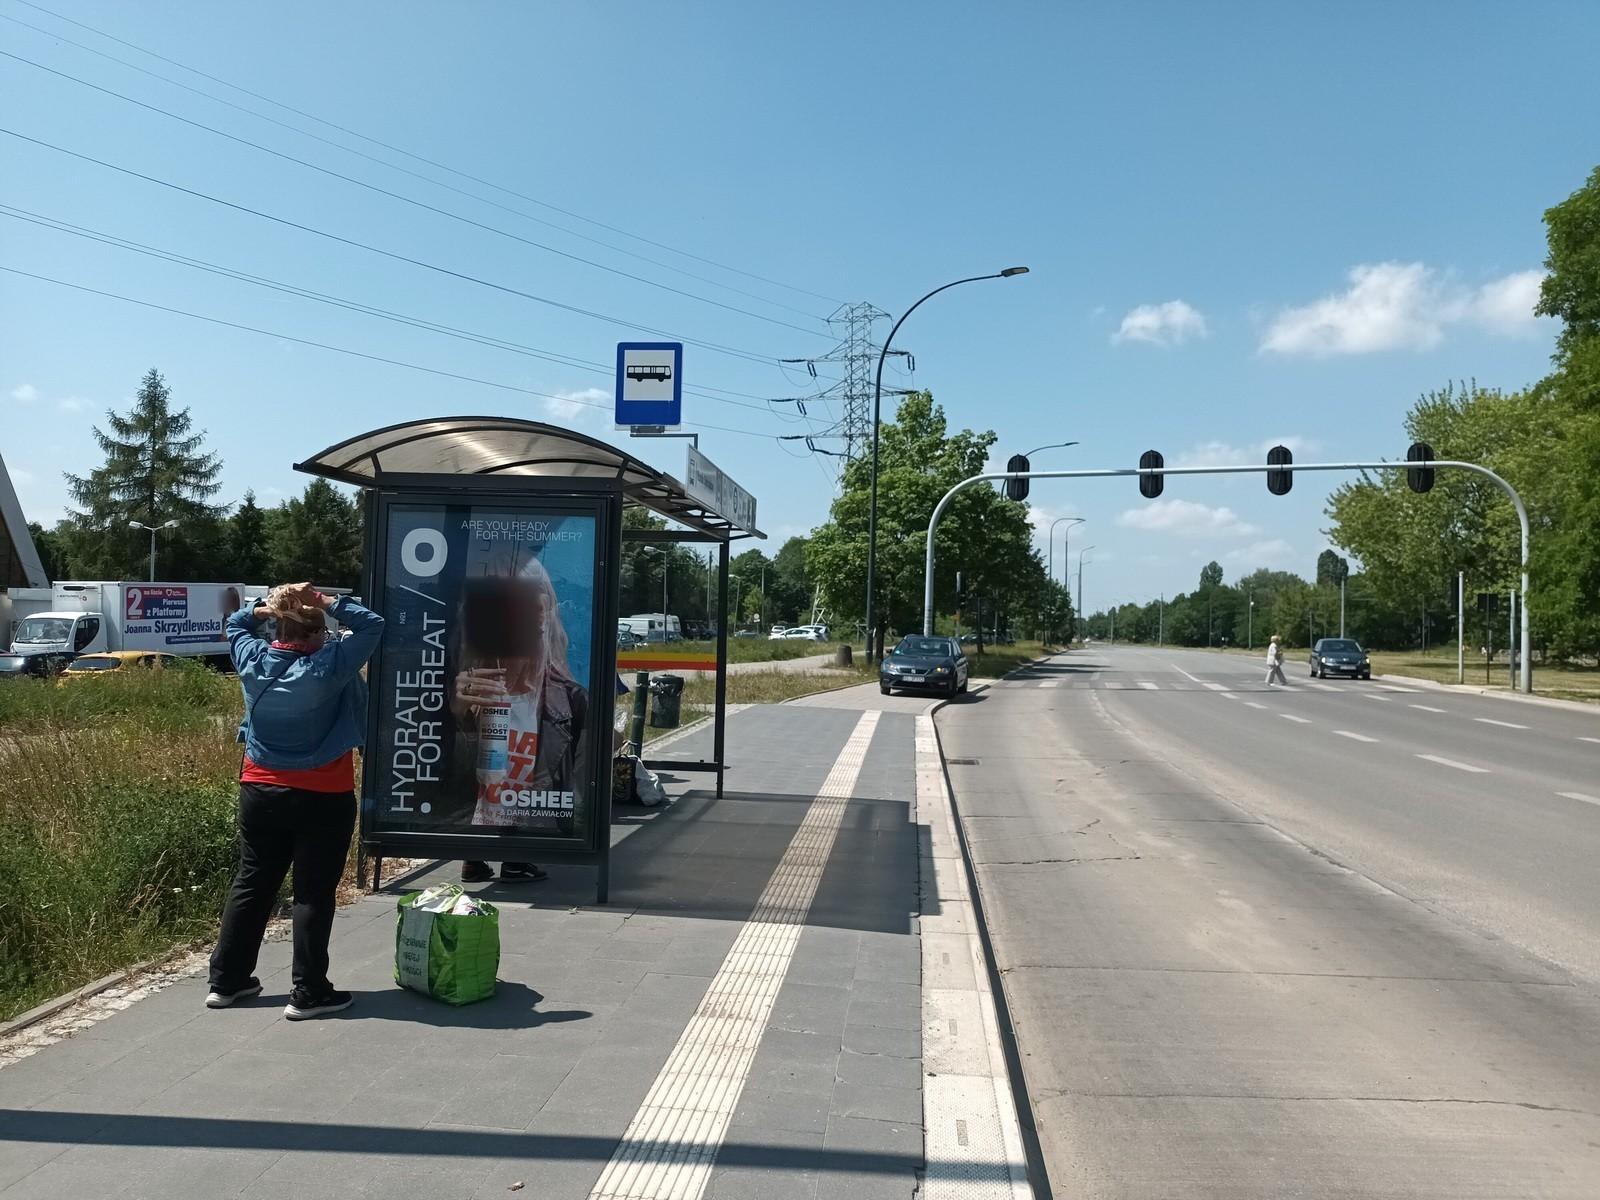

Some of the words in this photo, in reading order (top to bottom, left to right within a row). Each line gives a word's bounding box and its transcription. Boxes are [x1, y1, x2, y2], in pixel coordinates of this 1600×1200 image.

[461, 520, 483, 530] ARE
[486, 520, 509, 531] YOU
[511, 521, 550, 532] READY
[475, 530, 499, 541] FOR
[501, 530, 525, 541] THE
[526, 531, 583, 542] SUMMER?
[127, 588, 143, 616] 2
[162, 598, 186, 606] Pierwsza
[152, 607, 186, 618] Platformy
[124, 624, 152, 634] Joanna
[154, 619, 221, 635] Skrzydlewska
[420, 611, 447, 712] GREAT
[482, 707, 509, 716] OSHEE
[390, 670, 420, 812] HYDRATE
[416, 720, 443, 782] FOR
[500, 789, 574, 809] OSHEE
[506, 809, 530, 817] DARIA
[531, 810, 574, 819] ZAWIAŁOW
